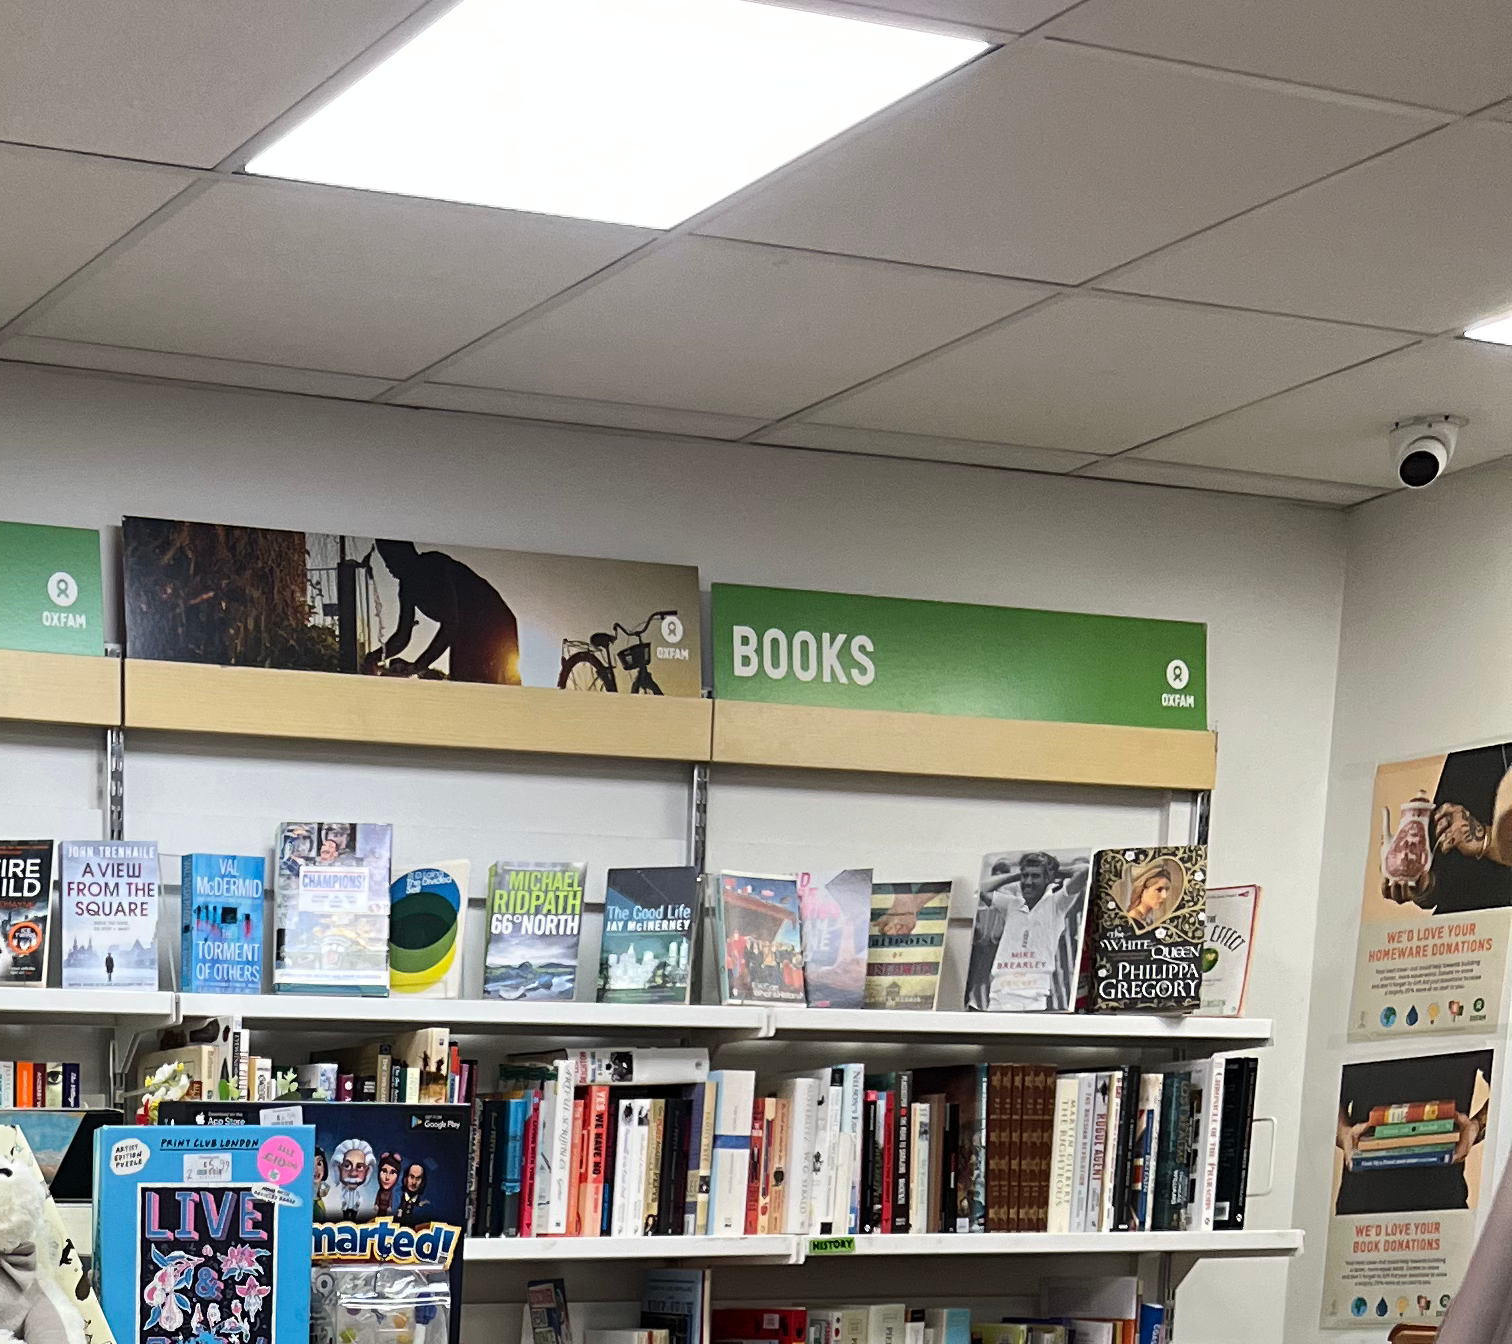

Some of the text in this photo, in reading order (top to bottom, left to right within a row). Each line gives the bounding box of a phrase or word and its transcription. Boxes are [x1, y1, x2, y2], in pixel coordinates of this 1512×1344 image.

[42, 610, 86, 629] OXFAM
[657, 647, 688, 661] OXFAM
[733, 625, 875, 686] BOOKS
[1162, 693, 1195, 708] OXFAM
[82, 862, 142, 878] A VIEW
[219, 858, 239, 876] VAL
[67, 882, 155, 898] FROM THE
[197, 876, 262, 898] McDERMID
[508, 871, 582, 892] MICHAEL
[75, 901, 149, 917] SQUARE
[493, 890, 581, 914] RIDPATH
[607, 903, 691, 920] The Good Life
[1387, 923, 1476, 944] WE'D LOVE YOUR
[197, 941, 260, 962] TORMENT
[1100, 939, 1151, 951] WHITE
[1151, 944, 1200, 962] QUEEN
[1369, 938, 1493, 963] HOMEWARE DONATIONS
[196, 963, 260, 983] OF OTHERS
[1118, 962, 1199, 980] PHILIPPA
[1099, 979, 1199, 1000] GREGORY
[146, 1191, 268, 1241] LIVE
[1355, 1222, 1441, 1237] WE'D LOVE YOUR
[812, 1239, 853, 1251] HISTORY
[1353, 1238, 1440, 1253] BOOK DONATIONS
